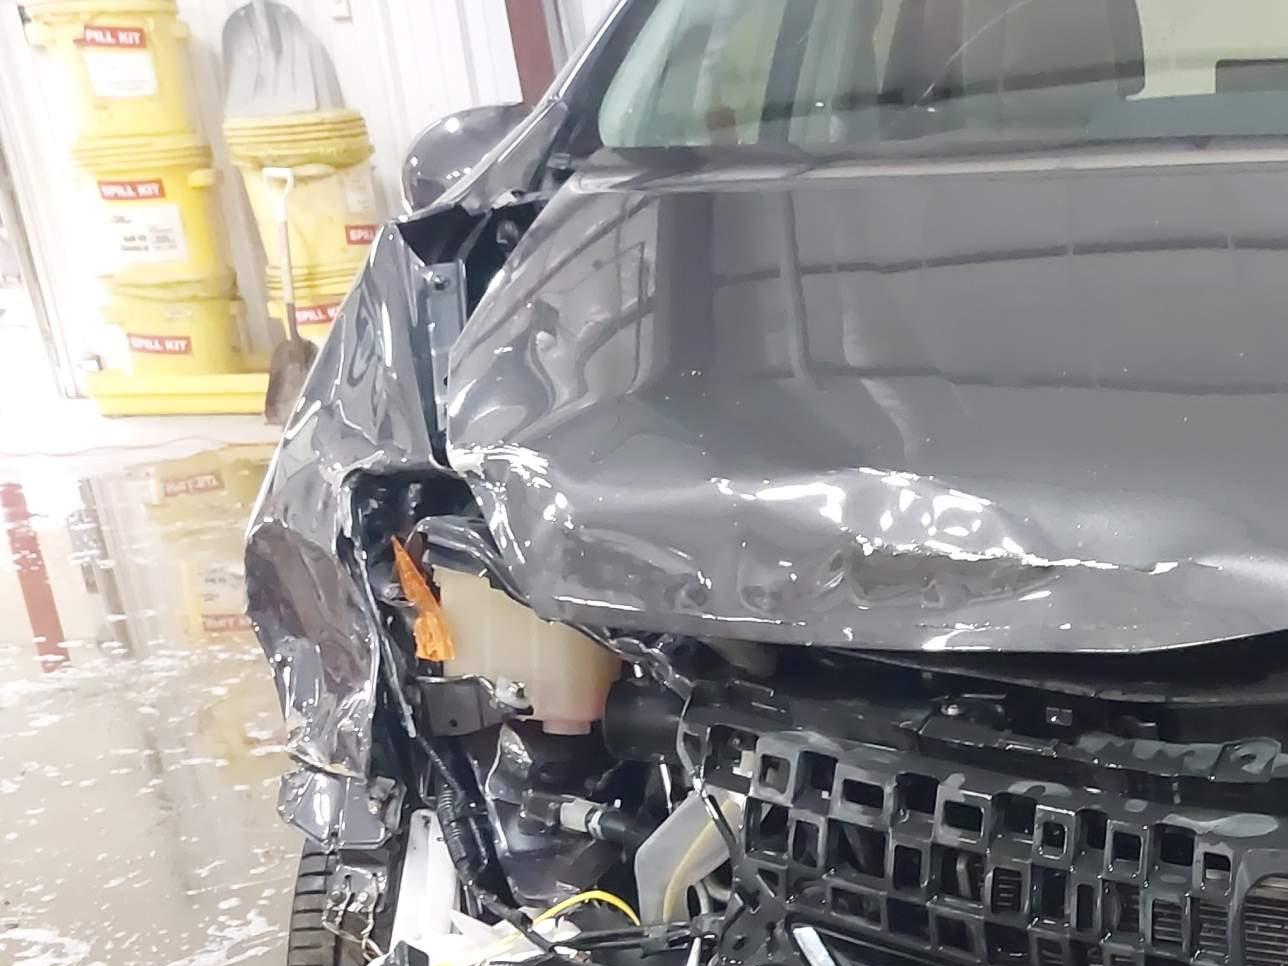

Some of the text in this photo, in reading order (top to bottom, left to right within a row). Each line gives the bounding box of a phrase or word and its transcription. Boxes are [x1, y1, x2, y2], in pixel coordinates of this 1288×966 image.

[79, 28, 140, 45] PILL KIT
[101, 182, 160, 198] SPILL KIT
[164, 339, 187, 352] KIT
